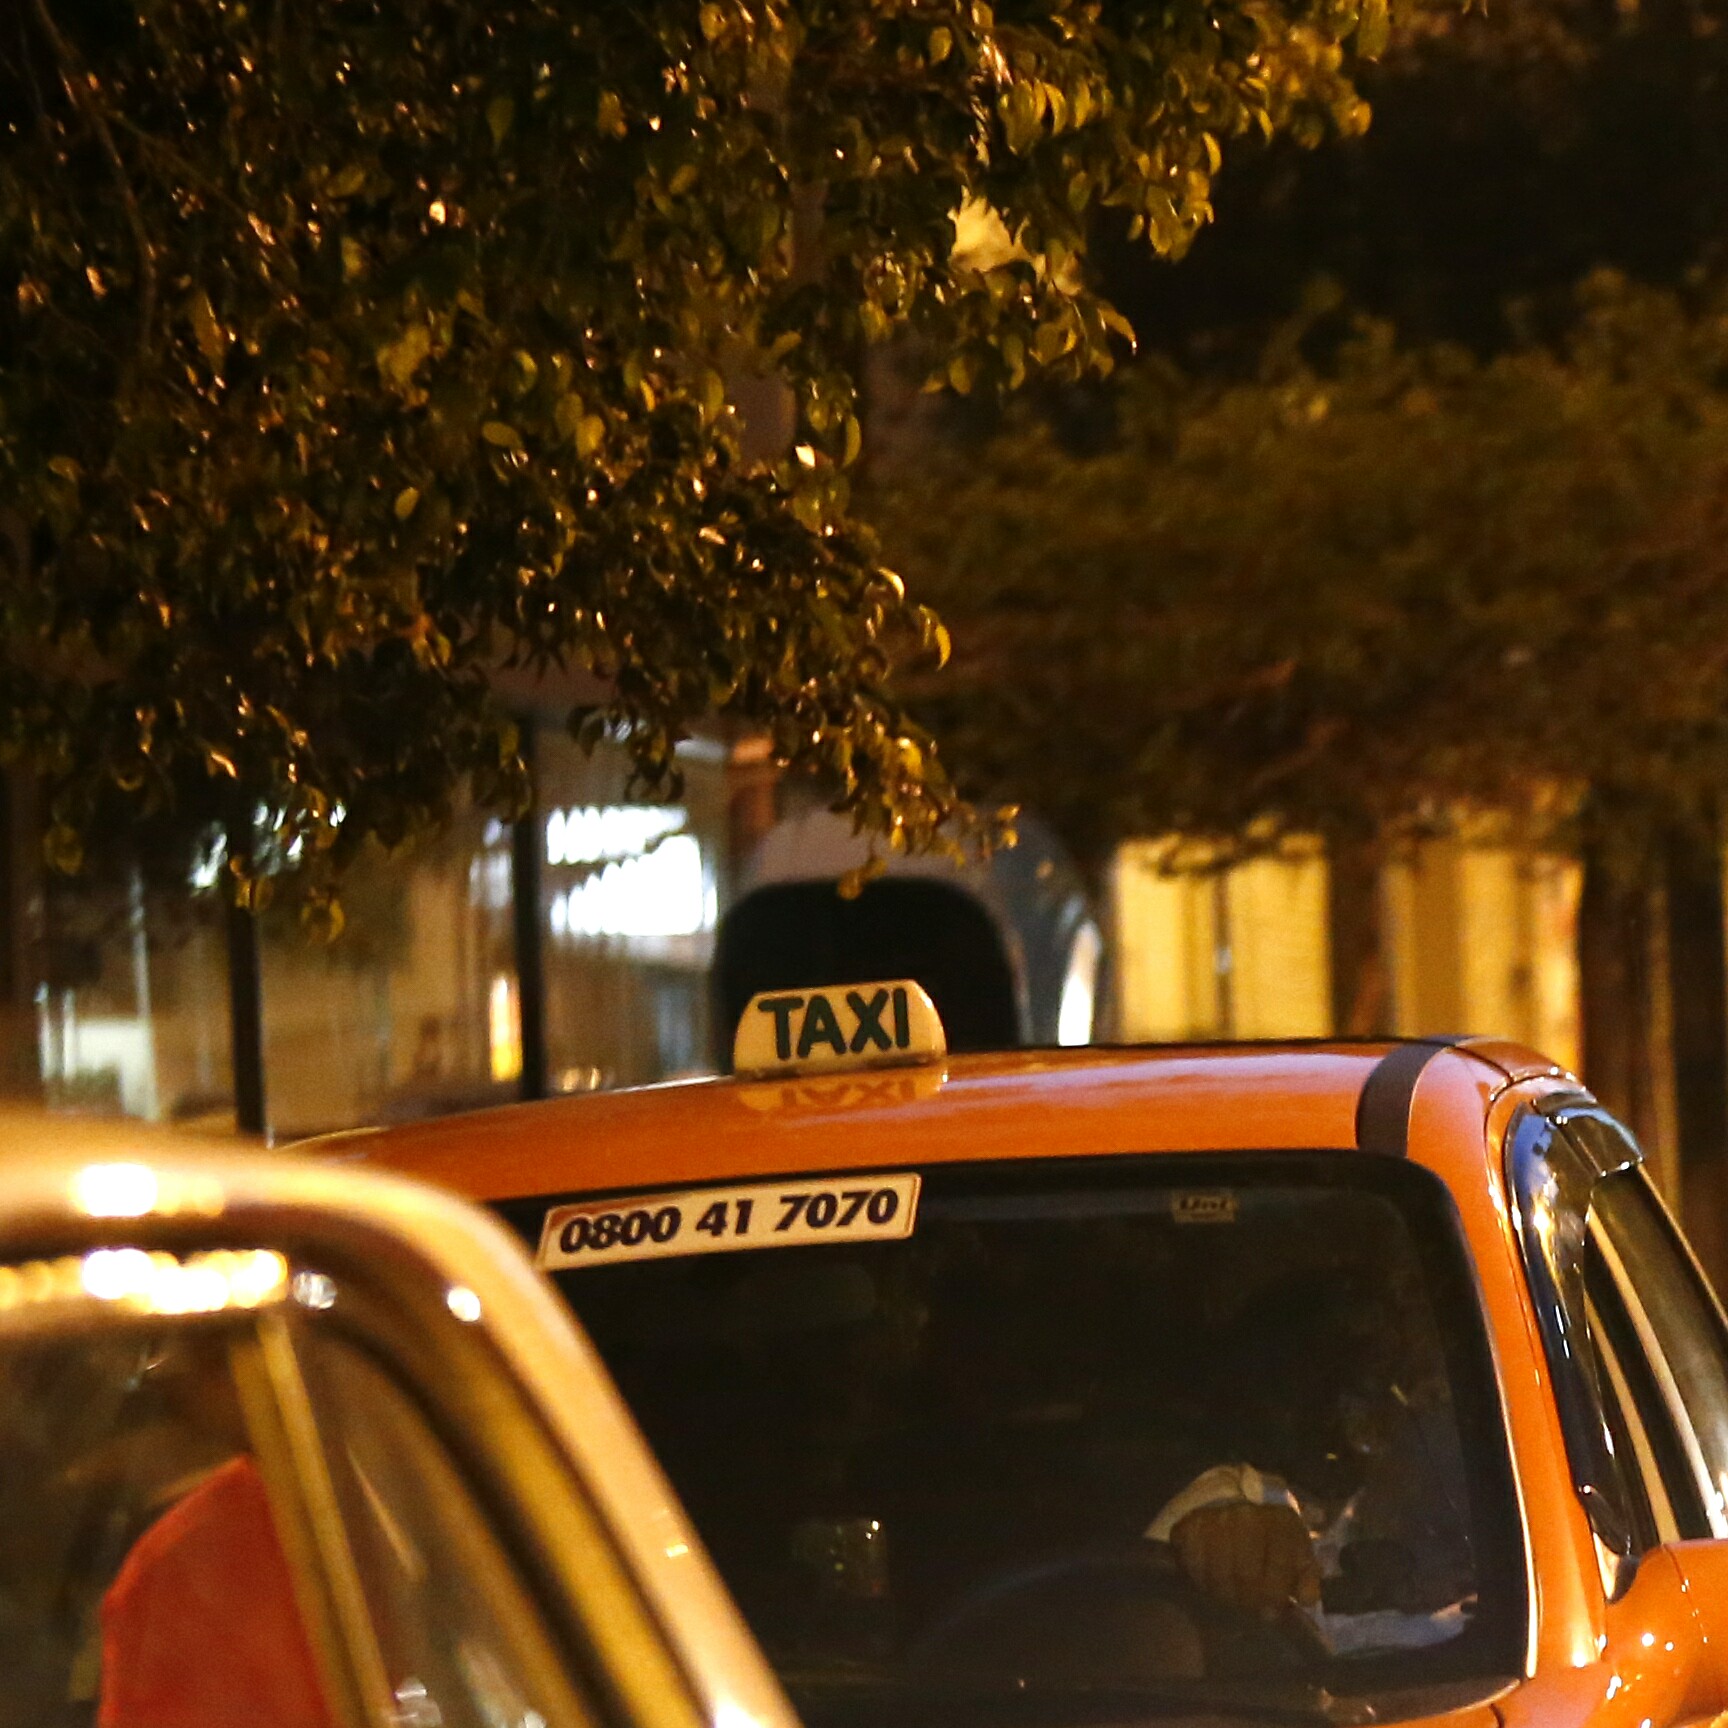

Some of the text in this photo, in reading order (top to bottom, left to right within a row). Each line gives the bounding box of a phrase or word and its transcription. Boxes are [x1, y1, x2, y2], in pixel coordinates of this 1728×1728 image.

[758, 986, 909, 1061] TAXI
[559, 1188, 899, 1254] 0800 41 7070
